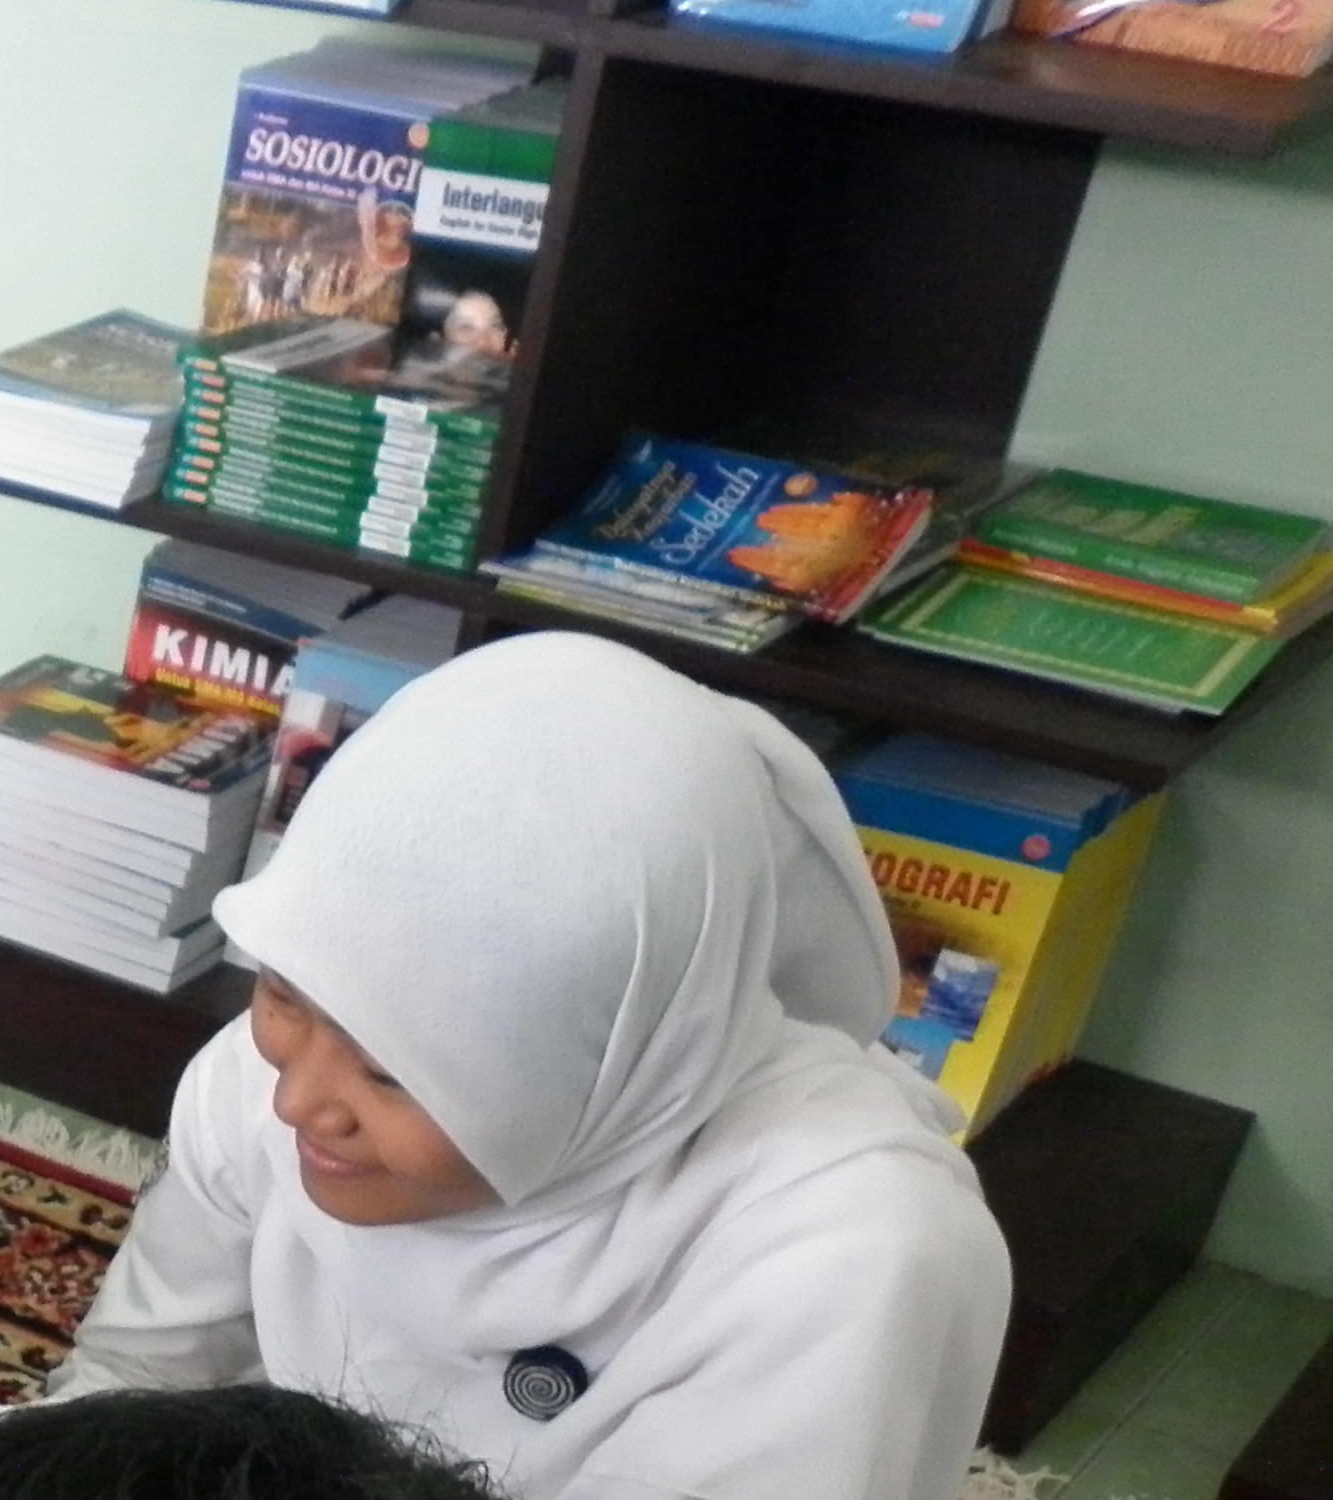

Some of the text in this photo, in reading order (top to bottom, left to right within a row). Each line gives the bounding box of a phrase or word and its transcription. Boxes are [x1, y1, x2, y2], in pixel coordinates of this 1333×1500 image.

[244, 126, 423, 193] SOSIOLOGI
[648, 461, 761, 565] Sedekah
[151, 621, 297, 697] KIMIA
[864, 848, 1012, 917] OGRAFI
